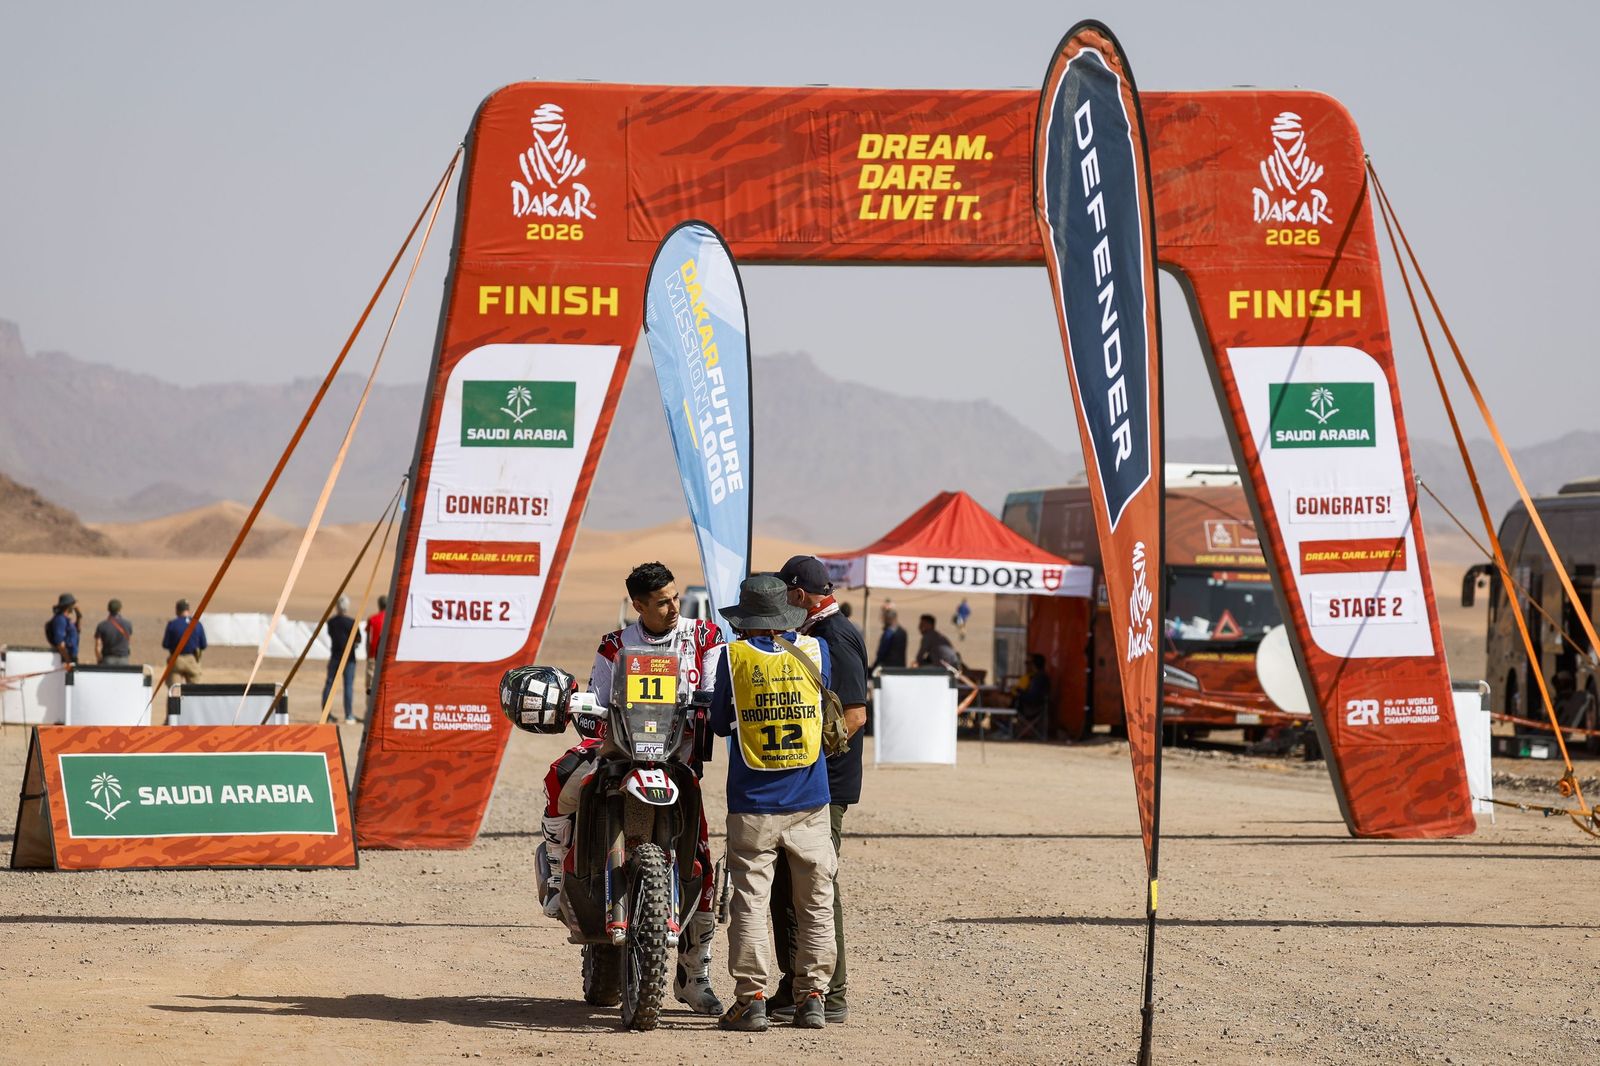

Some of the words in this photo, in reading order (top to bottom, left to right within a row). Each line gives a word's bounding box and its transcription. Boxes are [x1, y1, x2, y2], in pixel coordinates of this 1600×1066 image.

[857, 133, 994, 160] DREAM.
[858, 164, 962, 190] DARE.
[510, 180, 597, 220] DAKAR
[859, 194, 938, 220] LIVE
[942, 195, 982, 221] IT.
[1252, 187, 1334, 225] DAKAR
[526, 223, 584, 240] 2026
[1265, 229, 1320, 246] 2026
[1074, 100, 1134, 473] DEFENDER
[478, 285, 619, 316] FINISH
[1229, 289, 1362, 319] FINISH
[467, 428, 510, 440] SAUDI
[513, 429, 568, 441] ARABIA
[1276, 430, 1316, 442] SAUDI
[1319, 429, 1370, 441] ARABIA
[446, 495, 549, 516] CONGRATS!
[1296, 496, 1391, 515] CONGRATS!
[432, 552, 469, 561] DREAM.
[471, 553, 500, 562] DARE.
[501, 554, 524, 562] LIVE
[524, 554, 535, 563] IT.
[1305, 552, 1340, 561] DREAM.
[1342, 551, 1369, 560] DARE.
[1370, 550, 1391, 558] LIVE
[926, 565, 1034, 589] TUDOR
[431, 600, 493, 621] STAGE
[499, 601, 510, 621] 2
[1329, 597, 1387, 618] STAGE
[1392, 597, 1403, 617] 2
[639, 677, 664, 700] 11
[459, 705, 488, 713] WORLD
[755, 691, 804, 707] OFFICIAL
[1407, 697, 1434, 706] WORLD
[433, 712, 491, 723] RALLY-RAID
[741, 705, 816, 721] BROADCASTER
[1383, 705, 1438, 716] RALLY-RAID
[1384, 715, 1440, 725] CHAMPIONSHIP
[432, 722, 492, 731] CHAMPIONSHIP
[760, 723, 803, 751] 12
[138, 785, 213, 806] SAUDI
[220, 784, 314, 804] ARABIA
